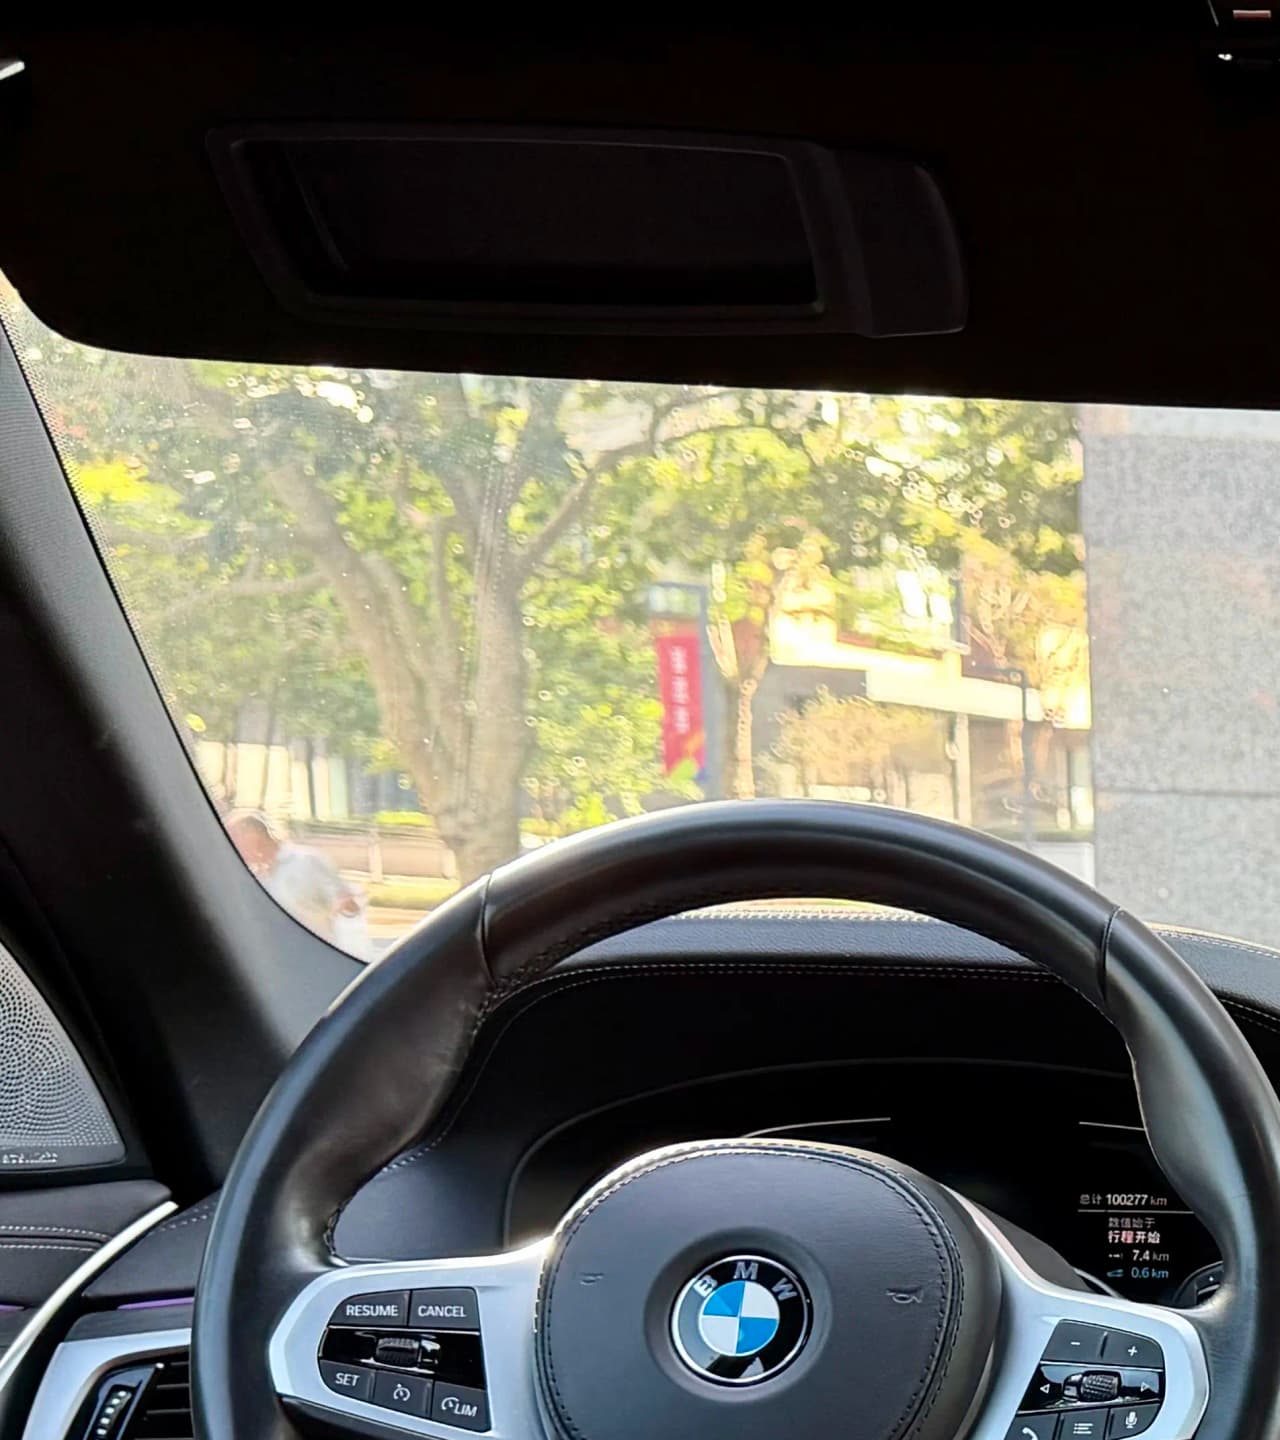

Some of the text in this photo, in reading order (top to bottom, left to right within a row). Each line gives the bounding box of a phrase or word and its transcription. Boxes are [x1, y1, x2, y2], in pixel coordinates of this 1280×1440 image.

[1105, 1193, 1148, 1206] 100277
[1150, 1196, 1168, 1206] km
[1107, 1230, 1161, 1244] 行程开始
[1132, 1249, 1170, 1262] 7.4 km
[1131, 1267, 1169, 1279] 0.6 km
[693, 1261, 798, 1301] BMW
[345, 1304, 467, 1318] RESUME CANCEL
[335, 1372, 360, 1387] SET
[453, 1403, 478, 1418] LIM
